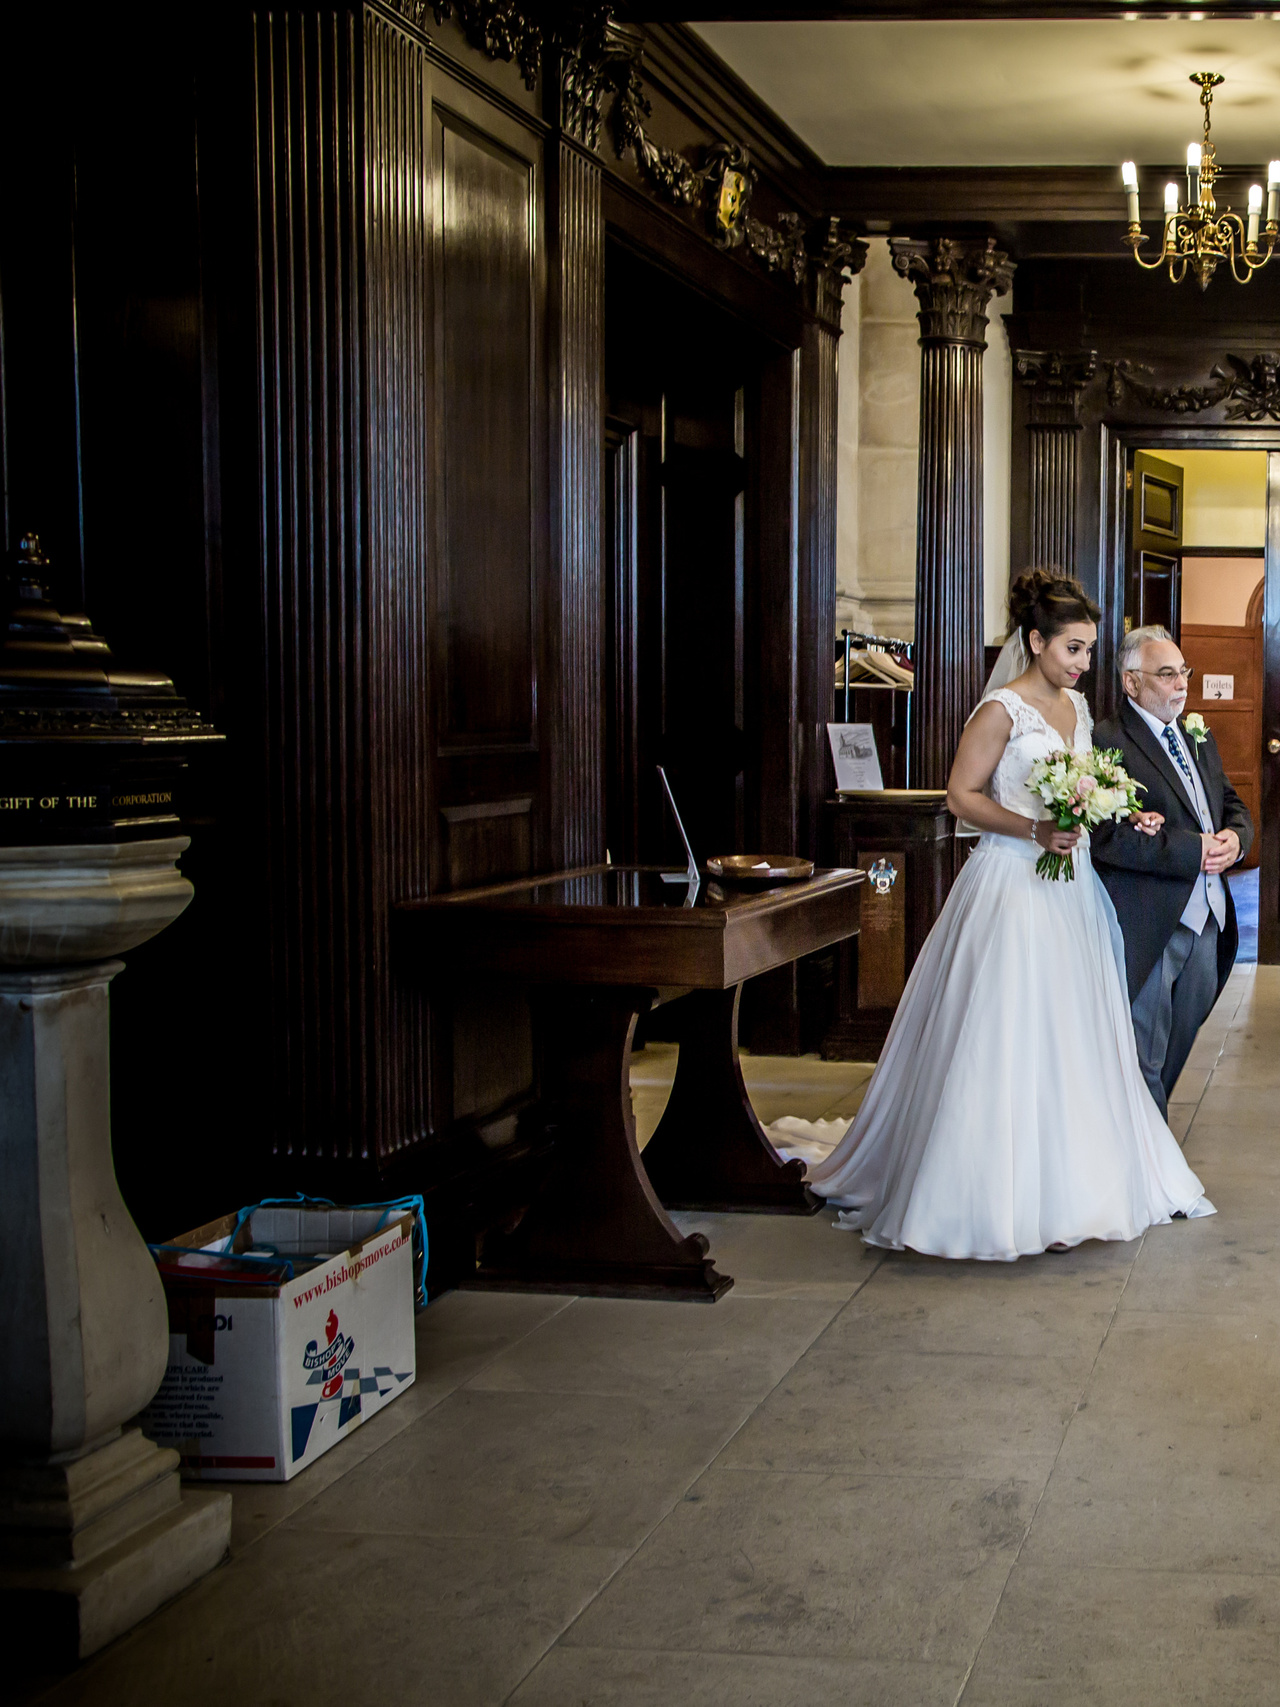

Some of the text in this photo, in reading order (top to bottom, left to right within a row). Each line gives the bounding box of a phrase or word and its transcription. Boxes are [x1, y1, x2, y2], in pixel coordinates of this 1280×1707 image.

[1205, 680, 1232, 690] Toilets
[0, 792, 172, 810] GIFT OF THE CORPORATION
[327, 1348, 351, 1379] MOVE
[189, 1375, 223, 1383] produced
[196, 1393, 215, 1401] from
